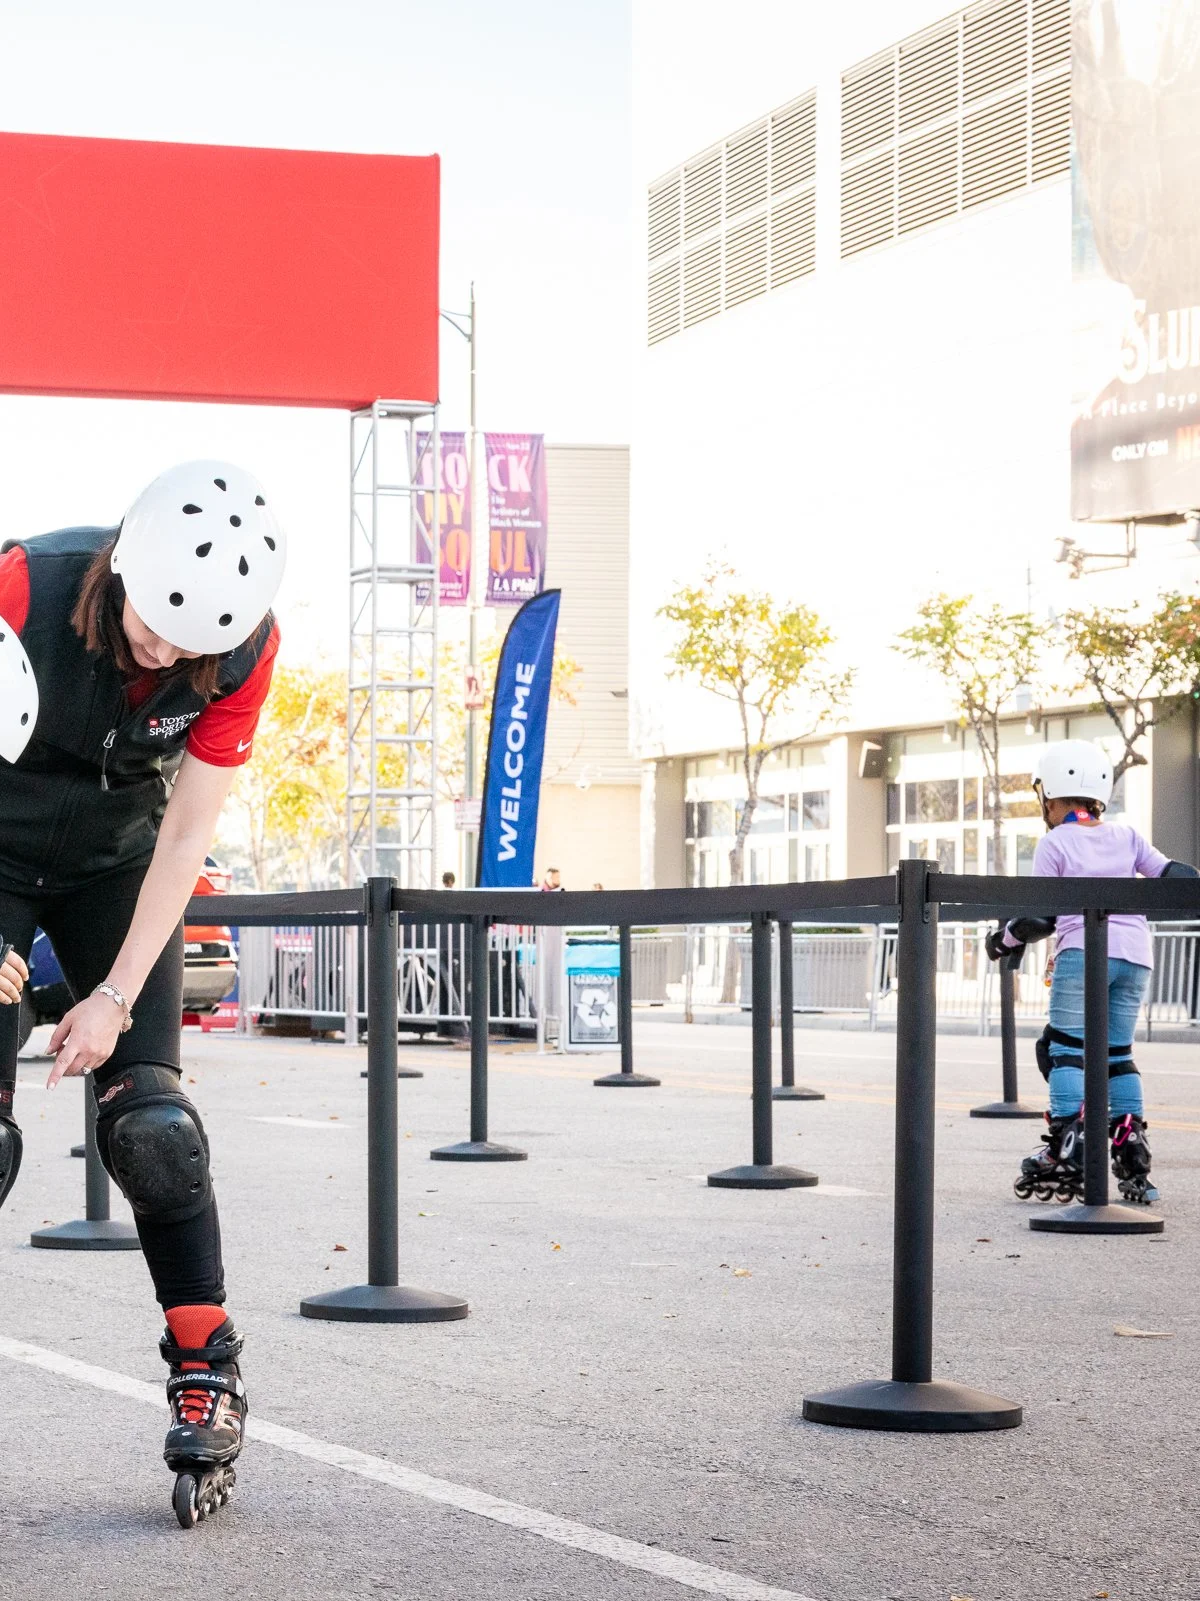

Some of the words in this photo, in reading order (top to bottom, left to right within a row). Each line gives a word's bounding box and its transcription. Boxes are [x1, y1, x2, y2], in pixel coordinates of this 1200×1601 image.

[1111, 442, 1147, 462] ONLY
[1147, 439, 1169, 457] ON
[160, 711, 200, 727] TOYOTA
[497, 662, 536, 862] WELCOME
[168, 1373, 230, 1386] ROLLERBLADE
